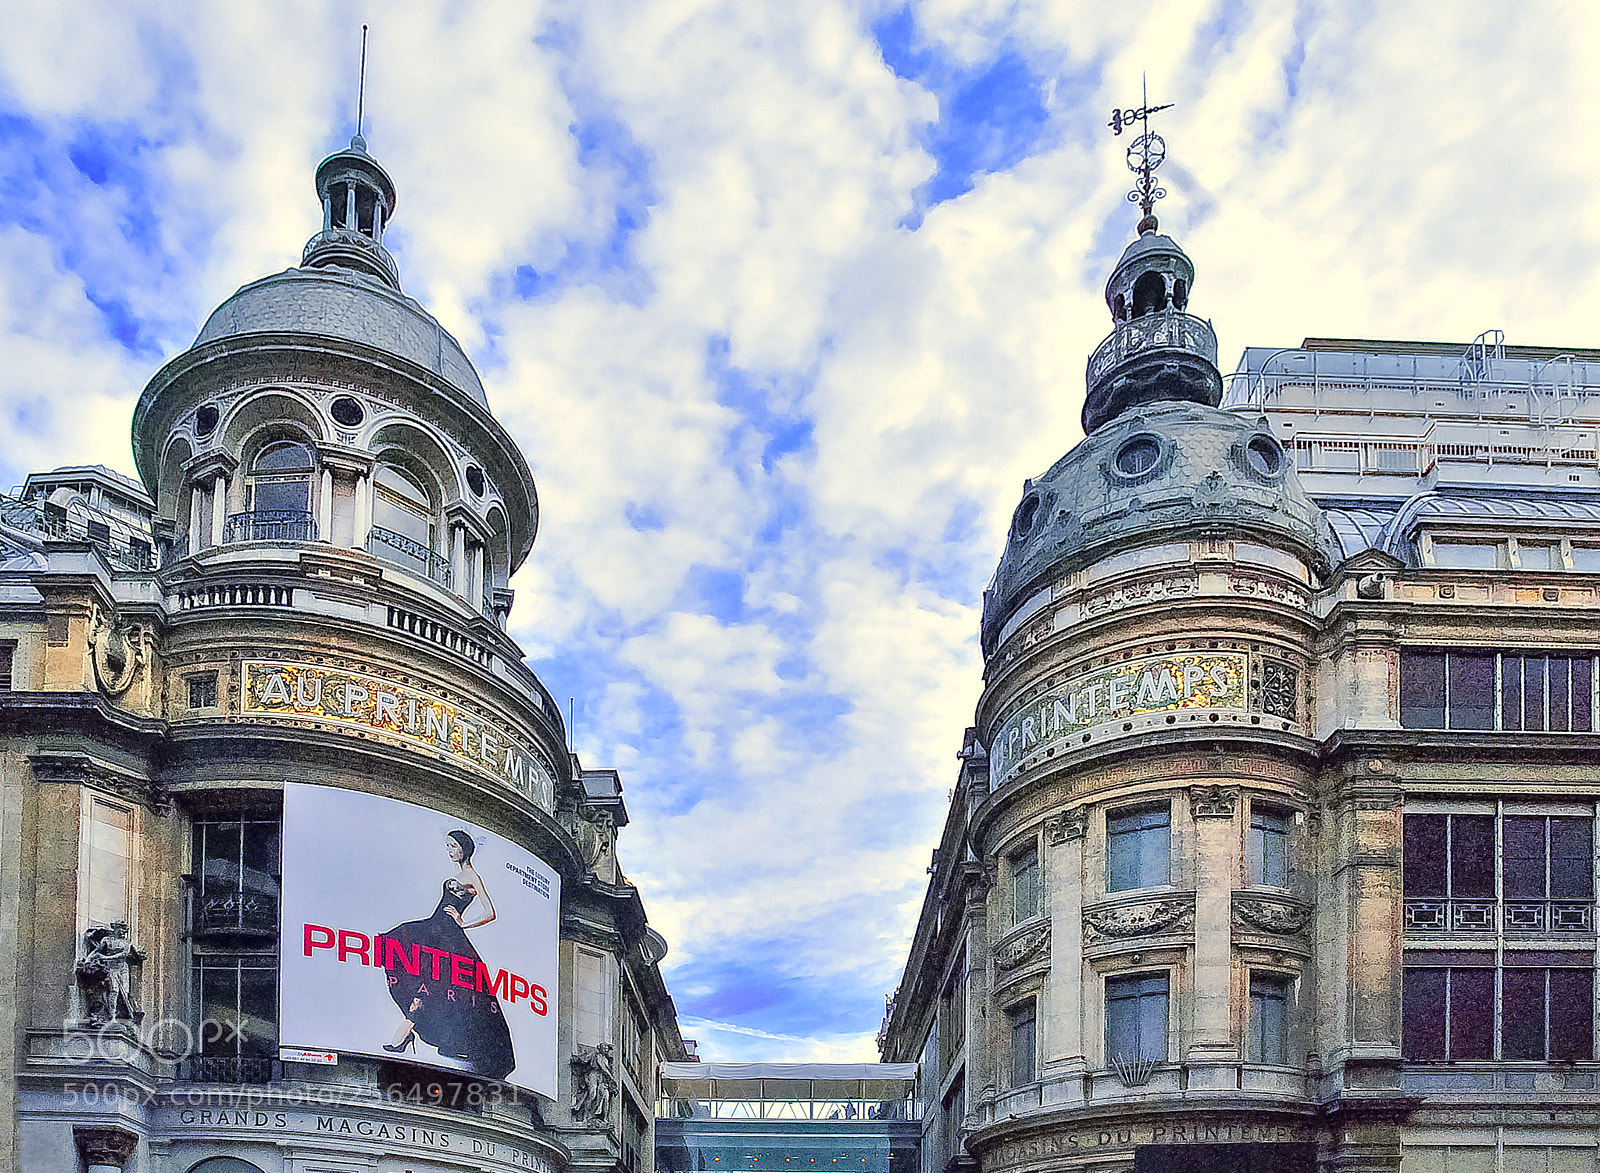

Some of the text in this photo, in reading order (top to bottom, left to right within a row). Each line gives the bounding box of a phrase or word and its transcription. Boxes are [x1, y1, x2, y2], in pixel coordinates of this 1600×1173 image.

[260, 673, 549, 808] AU PRINTEMPS
[1008, 665, 1229, 760] PRINTEMPS
[303, 923, 548, 1017] PRINTEMPS
[388, 975, 498, 1014] PARIS
[180, 1109, 287, 1128] GRANDS
[316, 1116, 450, 1148] MAGASINS
[473, 1139, 496, 1157] DU
[1099, 1129, 1132, 1146] DU
